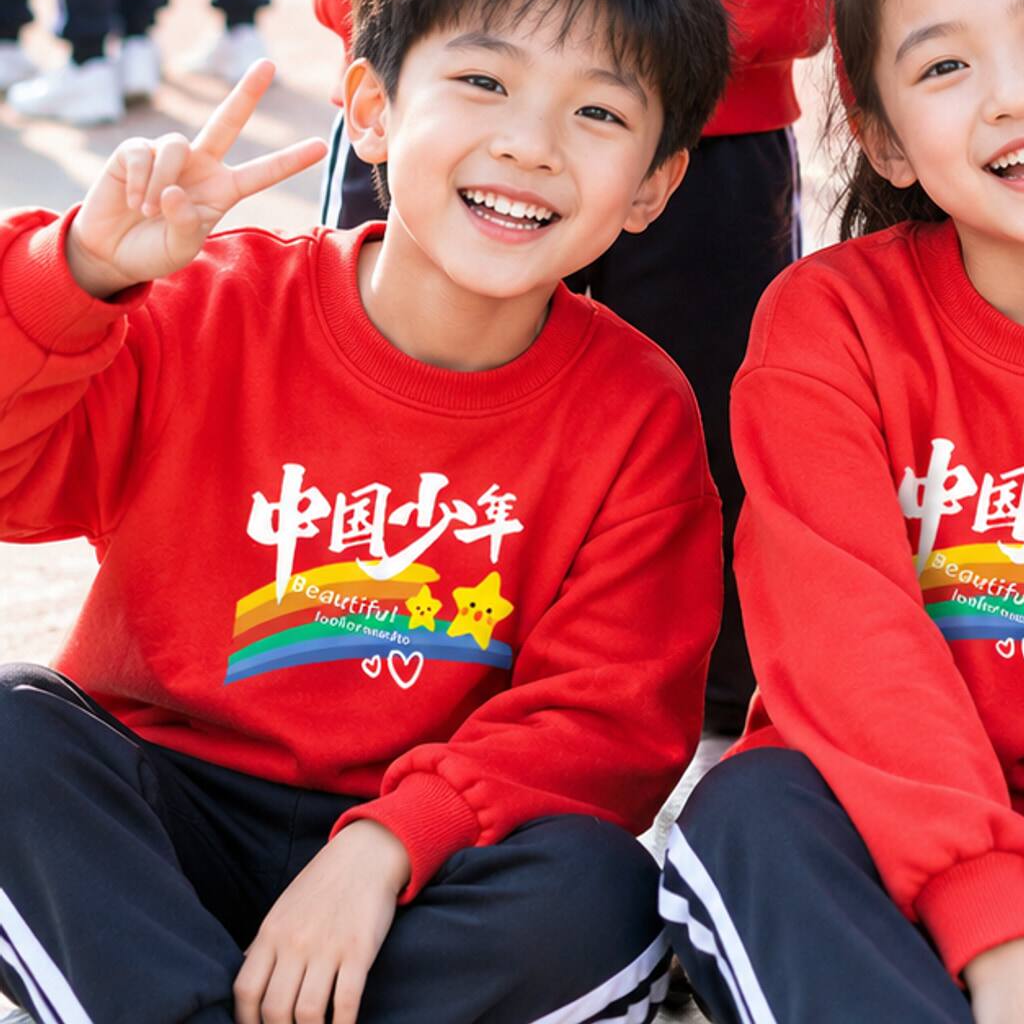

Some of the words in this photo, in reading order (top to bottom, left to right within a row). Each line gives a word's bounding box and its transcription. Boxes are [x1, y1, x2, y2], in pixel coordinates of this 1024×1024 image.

[247, 463, 524, 605] 中国少年
[292, 575, 398, 623] Beautiful
